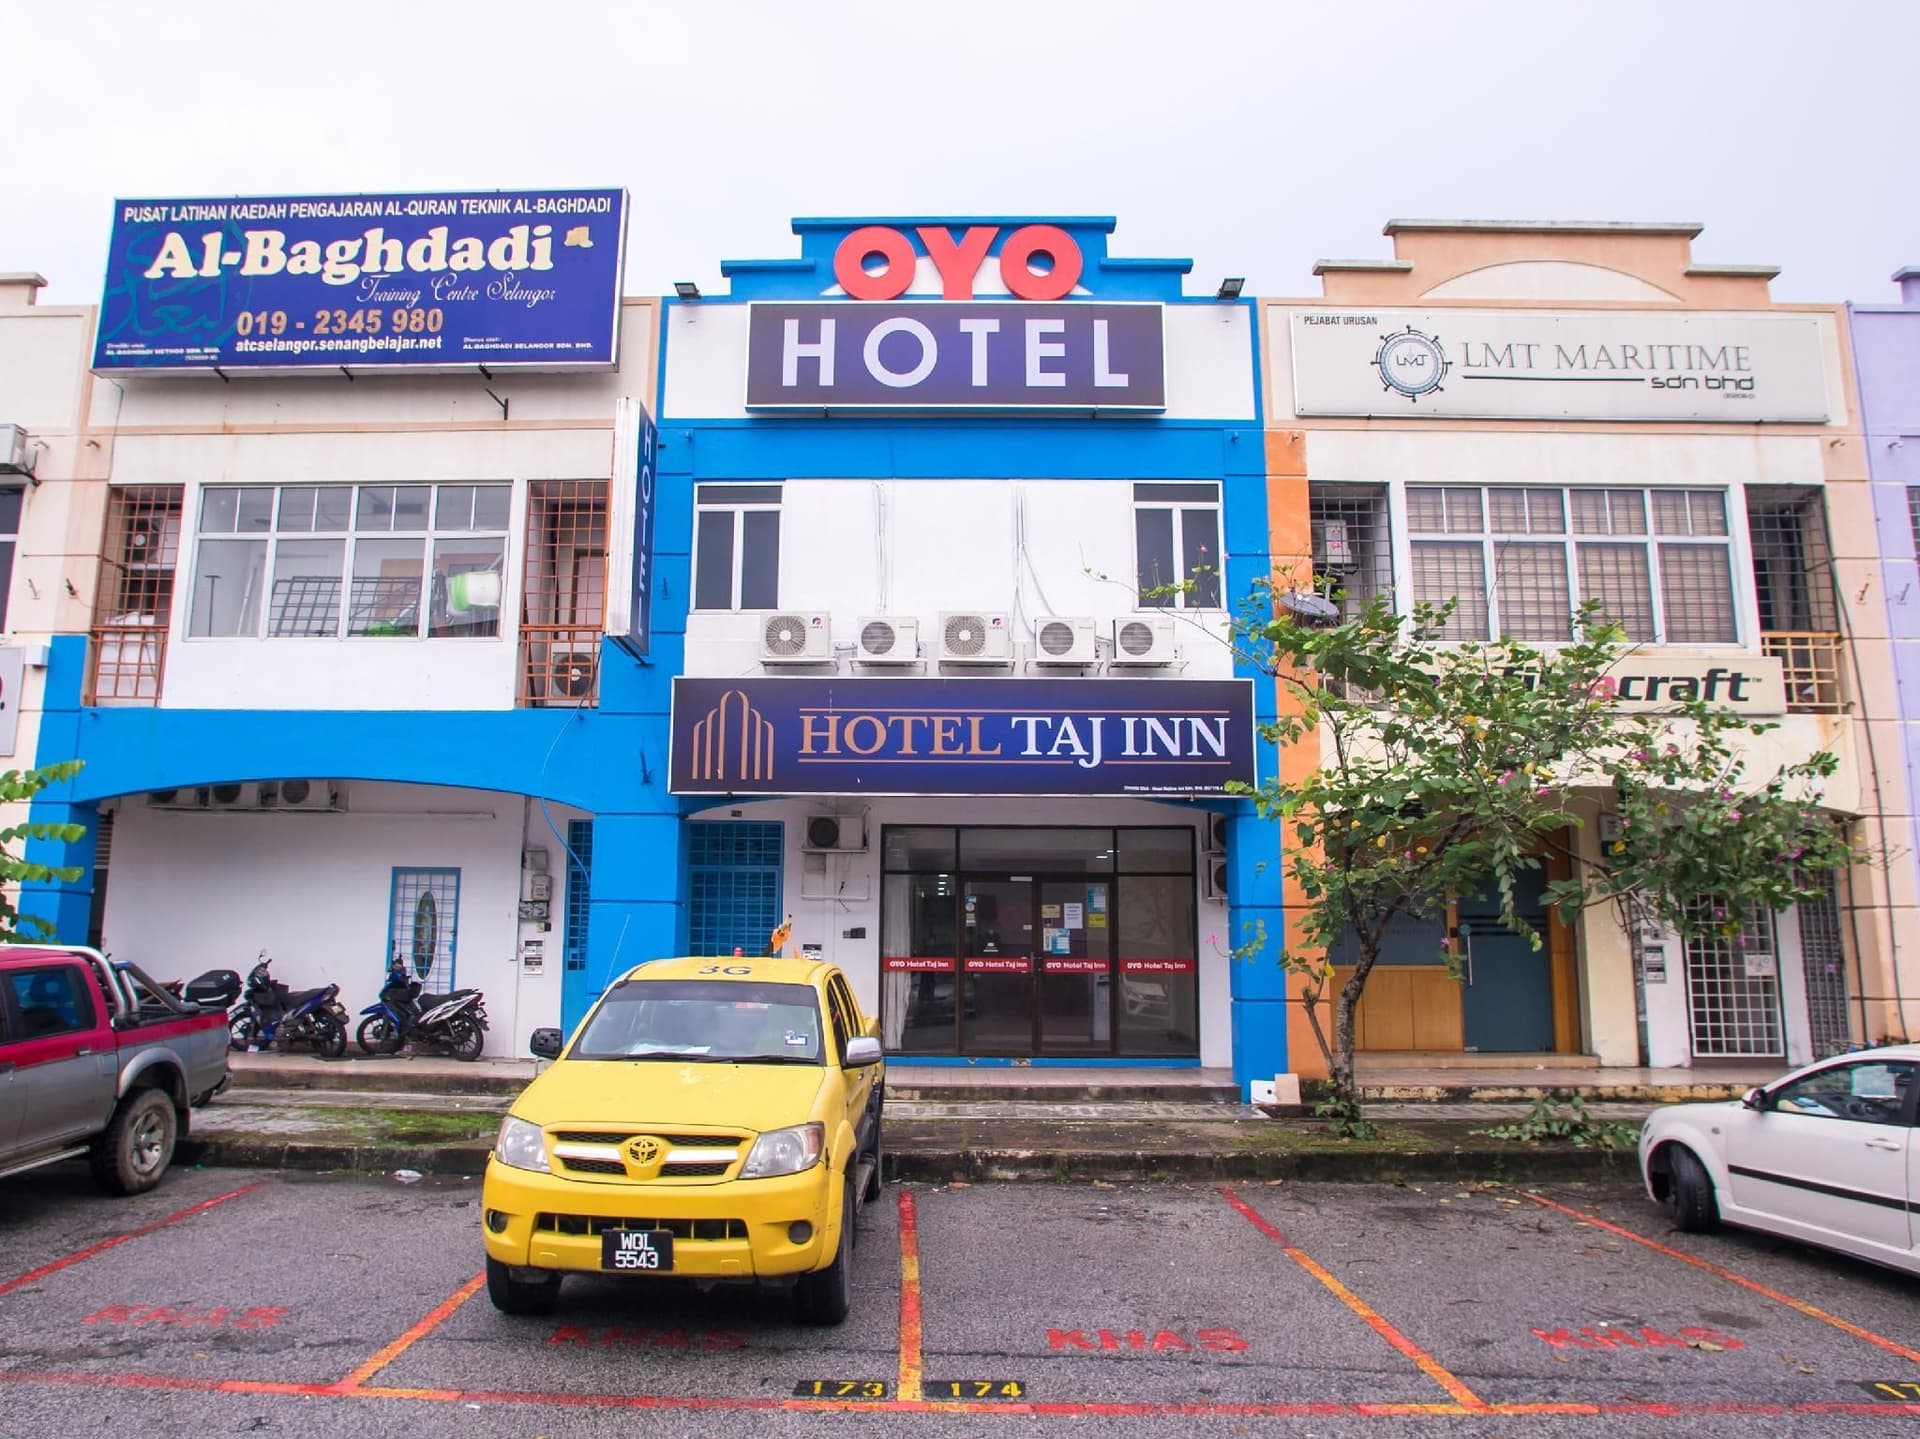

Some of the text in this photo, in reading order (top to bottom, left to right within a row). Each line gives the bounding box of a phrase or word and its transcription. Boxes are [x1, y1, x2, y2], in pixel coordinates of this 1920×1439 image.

[124, 197, 611, 223] PUSAT LATIHAN KAEDAH PENGAJARAN AL-QURAN TEKNIK AL-BAGHDADI
[143, 224, 554, 286] Al-Baghdadi
[833, 223, 1083, 301] OYO
[356, 271, 556, 308] Training Centre Selangor
[236, 310, 288, 336] 019
[313, 309, 383, 335] 2345
[392, 307, 443, 333] 980
[1304, 315, 1378, 326] PEJABAT URUSAN
[235, 335, 443, 355] atcselangor.senangbelajar.net
[782, 316, 1130, 388] HOTEL
[1460, 341, 1752, 372] LMT MARITIME
[1651, 375, 1755, 391] sdn bhd
[637, 420, 652, 637] HOTEL
[799, 715, 1232, 769] HOTEL TAJ INN
[698, 966, 752, 976] 3G
[906, 960, 926, 968] Hotel
[985, 961, 1004, 969] Hotel
[1063, 962, 1082, 970] Hotel
[1144, 962, 1163, 970] Hotel
[614, 1250, 659, 1269] 5543
[1045, 1328, 1250, 1352] KHAS
[811, 1380, 884, 1398] 173
[950, 1381, 1021, 1399] 174
